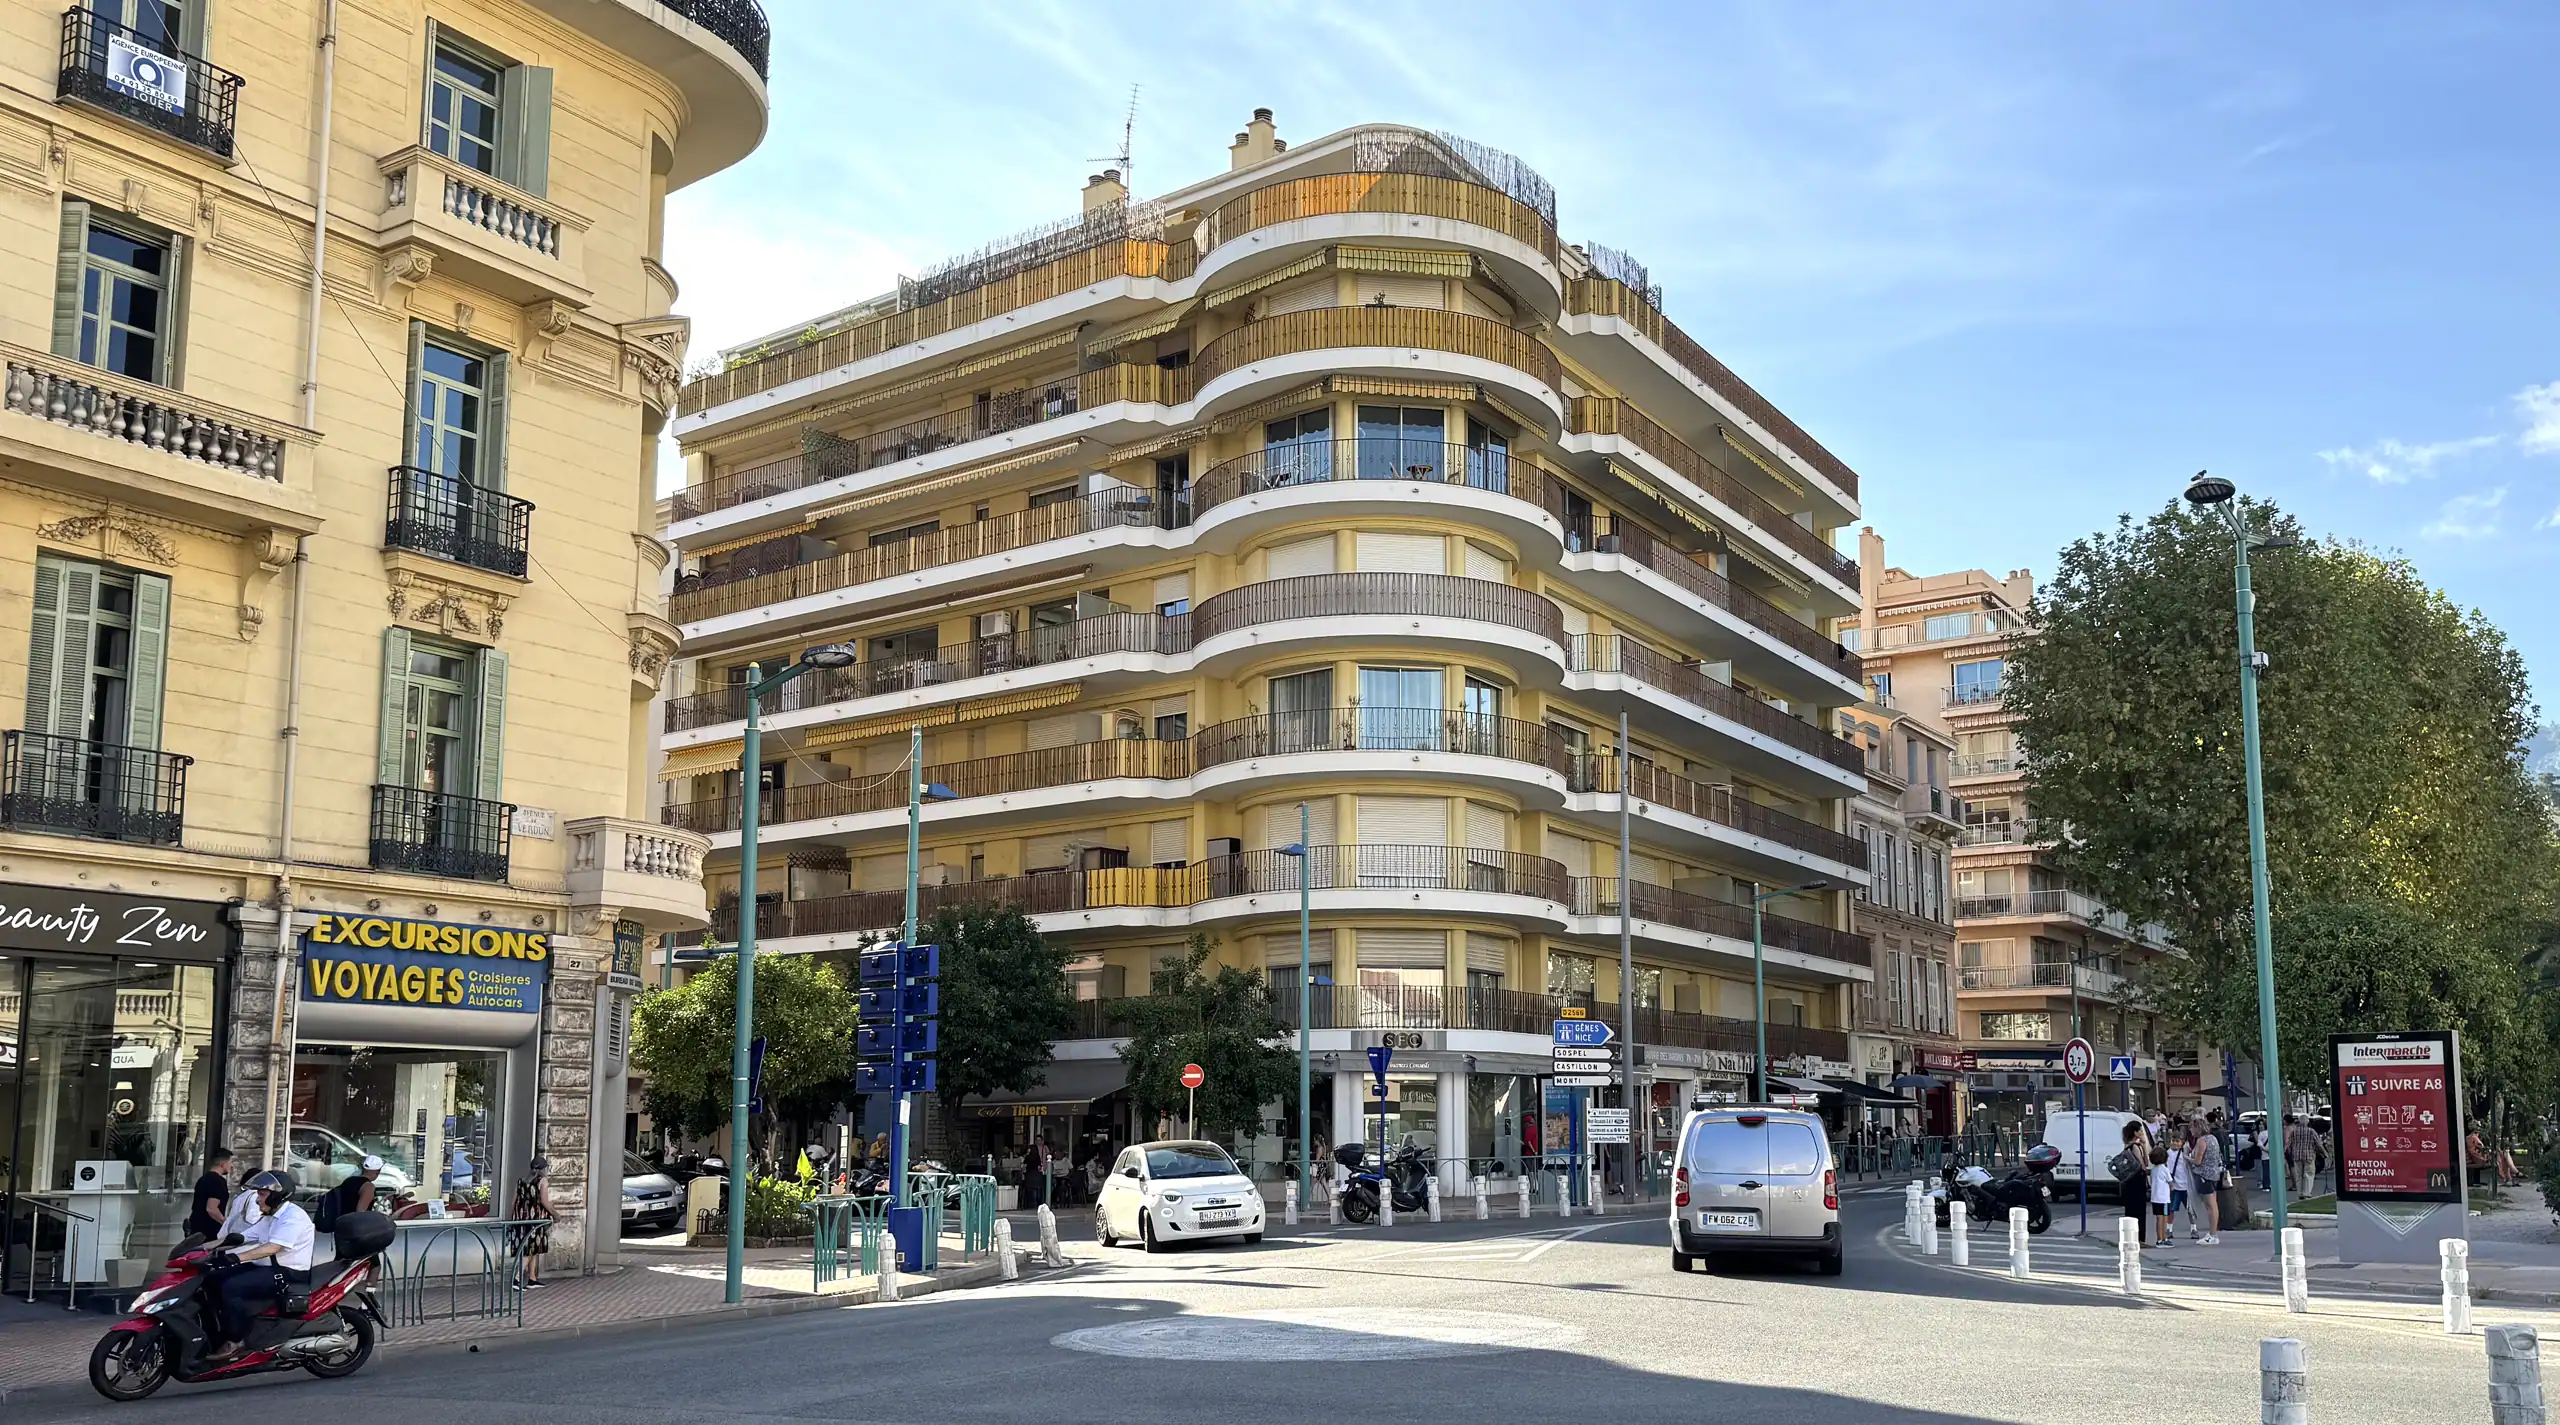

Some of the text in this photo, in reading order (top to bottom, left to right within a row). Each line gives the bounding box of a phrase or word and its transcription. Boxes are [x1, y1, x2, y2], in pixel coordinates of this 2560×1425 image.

[111, 38, 139, 54] AGENCE
[119, 85, 127, 94] A
[133, 89, 173, 113] LOUER
[522, 809, 546, 818] AVENUE
[517, 823, 551, 836] VERDUN
[0, 903, 208, 946] eauty Zen
[312, 914, 547, 962] EXCURSIONS
[570, 960, 581, 968] 27
[311, 958, 465, 1005] VOYAGES
[468, 984, 517, 997] Aviation
[468, 995, 523, 1009] Autocars
[1575, 1023, 1600, 1032] GÊNES
[1385, 1034, 1421, 1047] SFC
[1575, 1034, 1592, 1042] NICE
[1557, 1049, 1587, 1057] SOSPEL
[2371, 1078, 2443, 1091] SUIVRE A8
[1012, 1104, 1048, 1117] Thiers
[2348, 1160, 2387, 1168] MENTON
[2348, 1168, 2395, 1177] ST-ROMAN
[1709, 1215, 1719, 1224] FW
[1737, 1216, 1748, 1225] CZ
